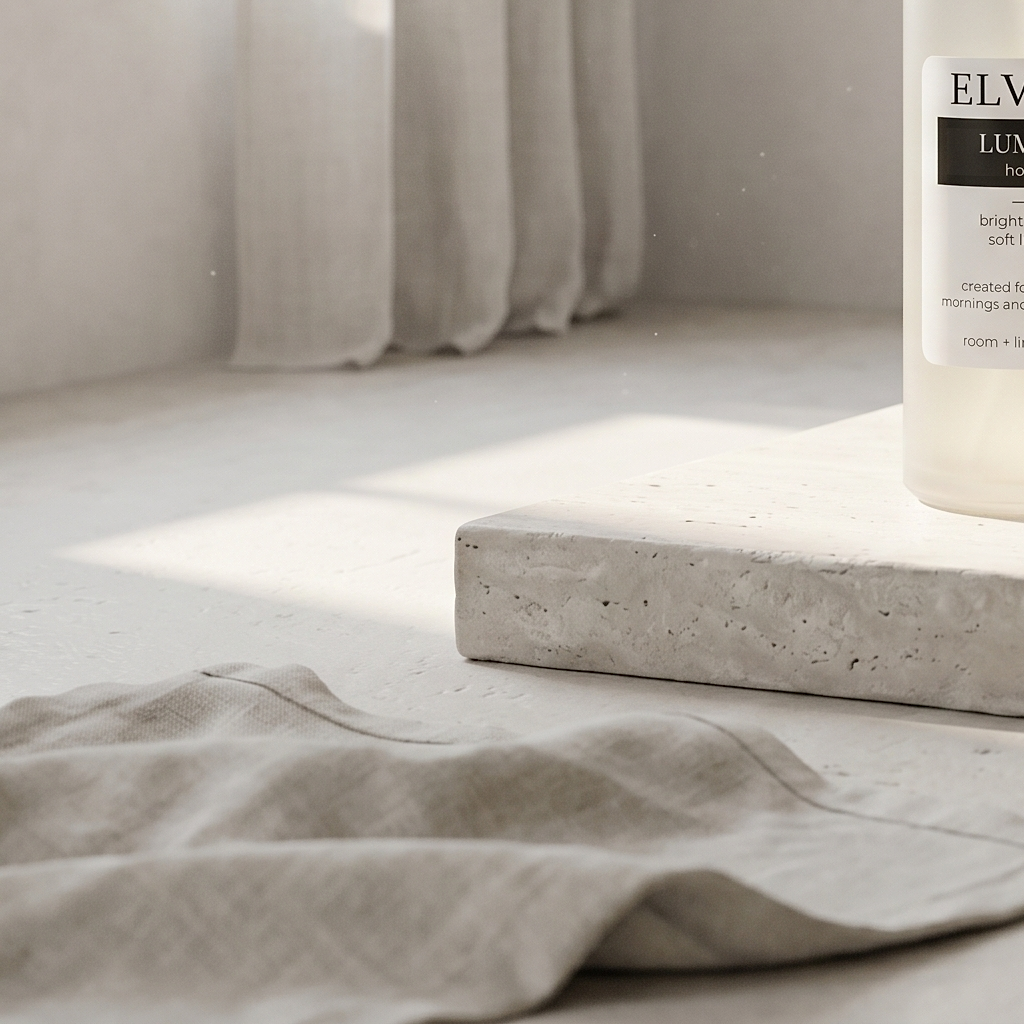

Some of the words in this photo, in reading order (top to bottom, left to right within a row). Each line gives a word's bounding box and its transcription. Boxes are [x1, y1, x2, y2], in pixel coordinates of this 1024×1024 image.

[979, 213, 1024, 230] bright
[988, 232, 1016, 246] soft
[961, 280, 1011, 293] created
[941, 297, 1000, 313] mornings
[963, 337, 998, 348] room
